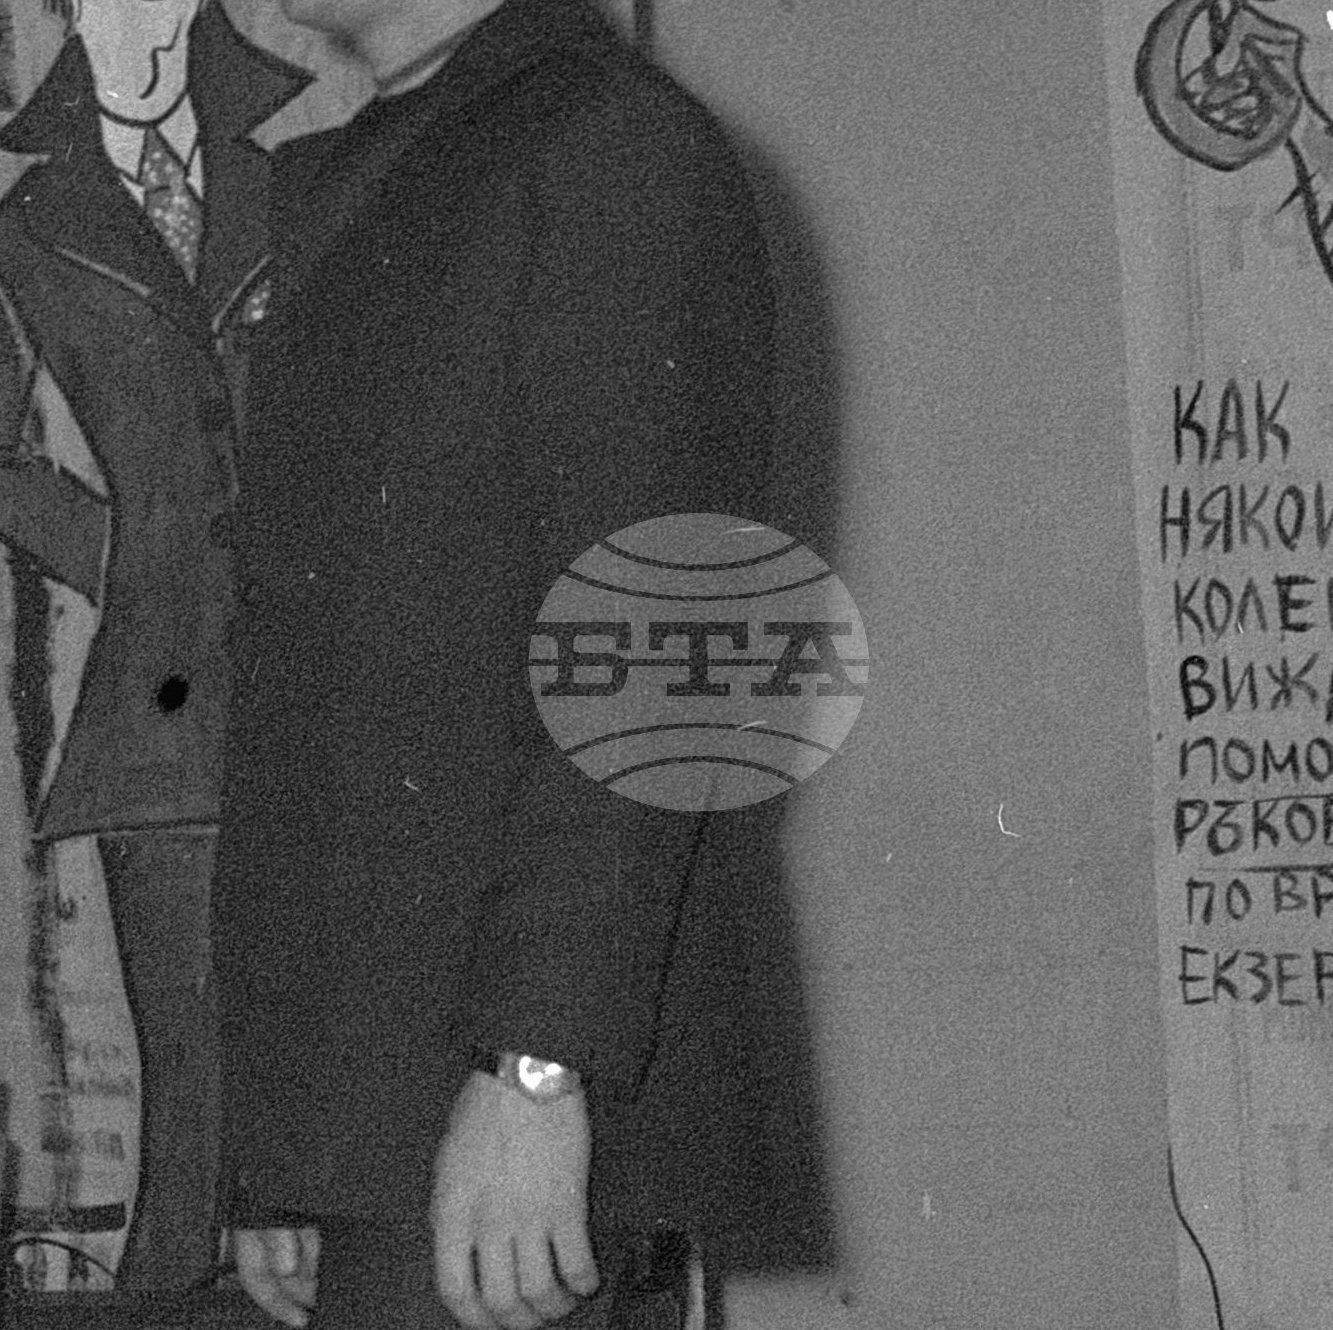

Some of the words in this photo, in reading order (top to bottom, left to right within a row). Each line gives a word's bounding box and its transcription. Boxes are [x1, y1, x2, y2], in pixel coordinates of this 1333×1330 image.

[1173, 377, 1291, 465] КАК
[1173, 573, 1333, 647] КОЛЕ
[1178, 651, 1333, 725] ВИЖ
[1185, 876, 1253, 927] ПО
